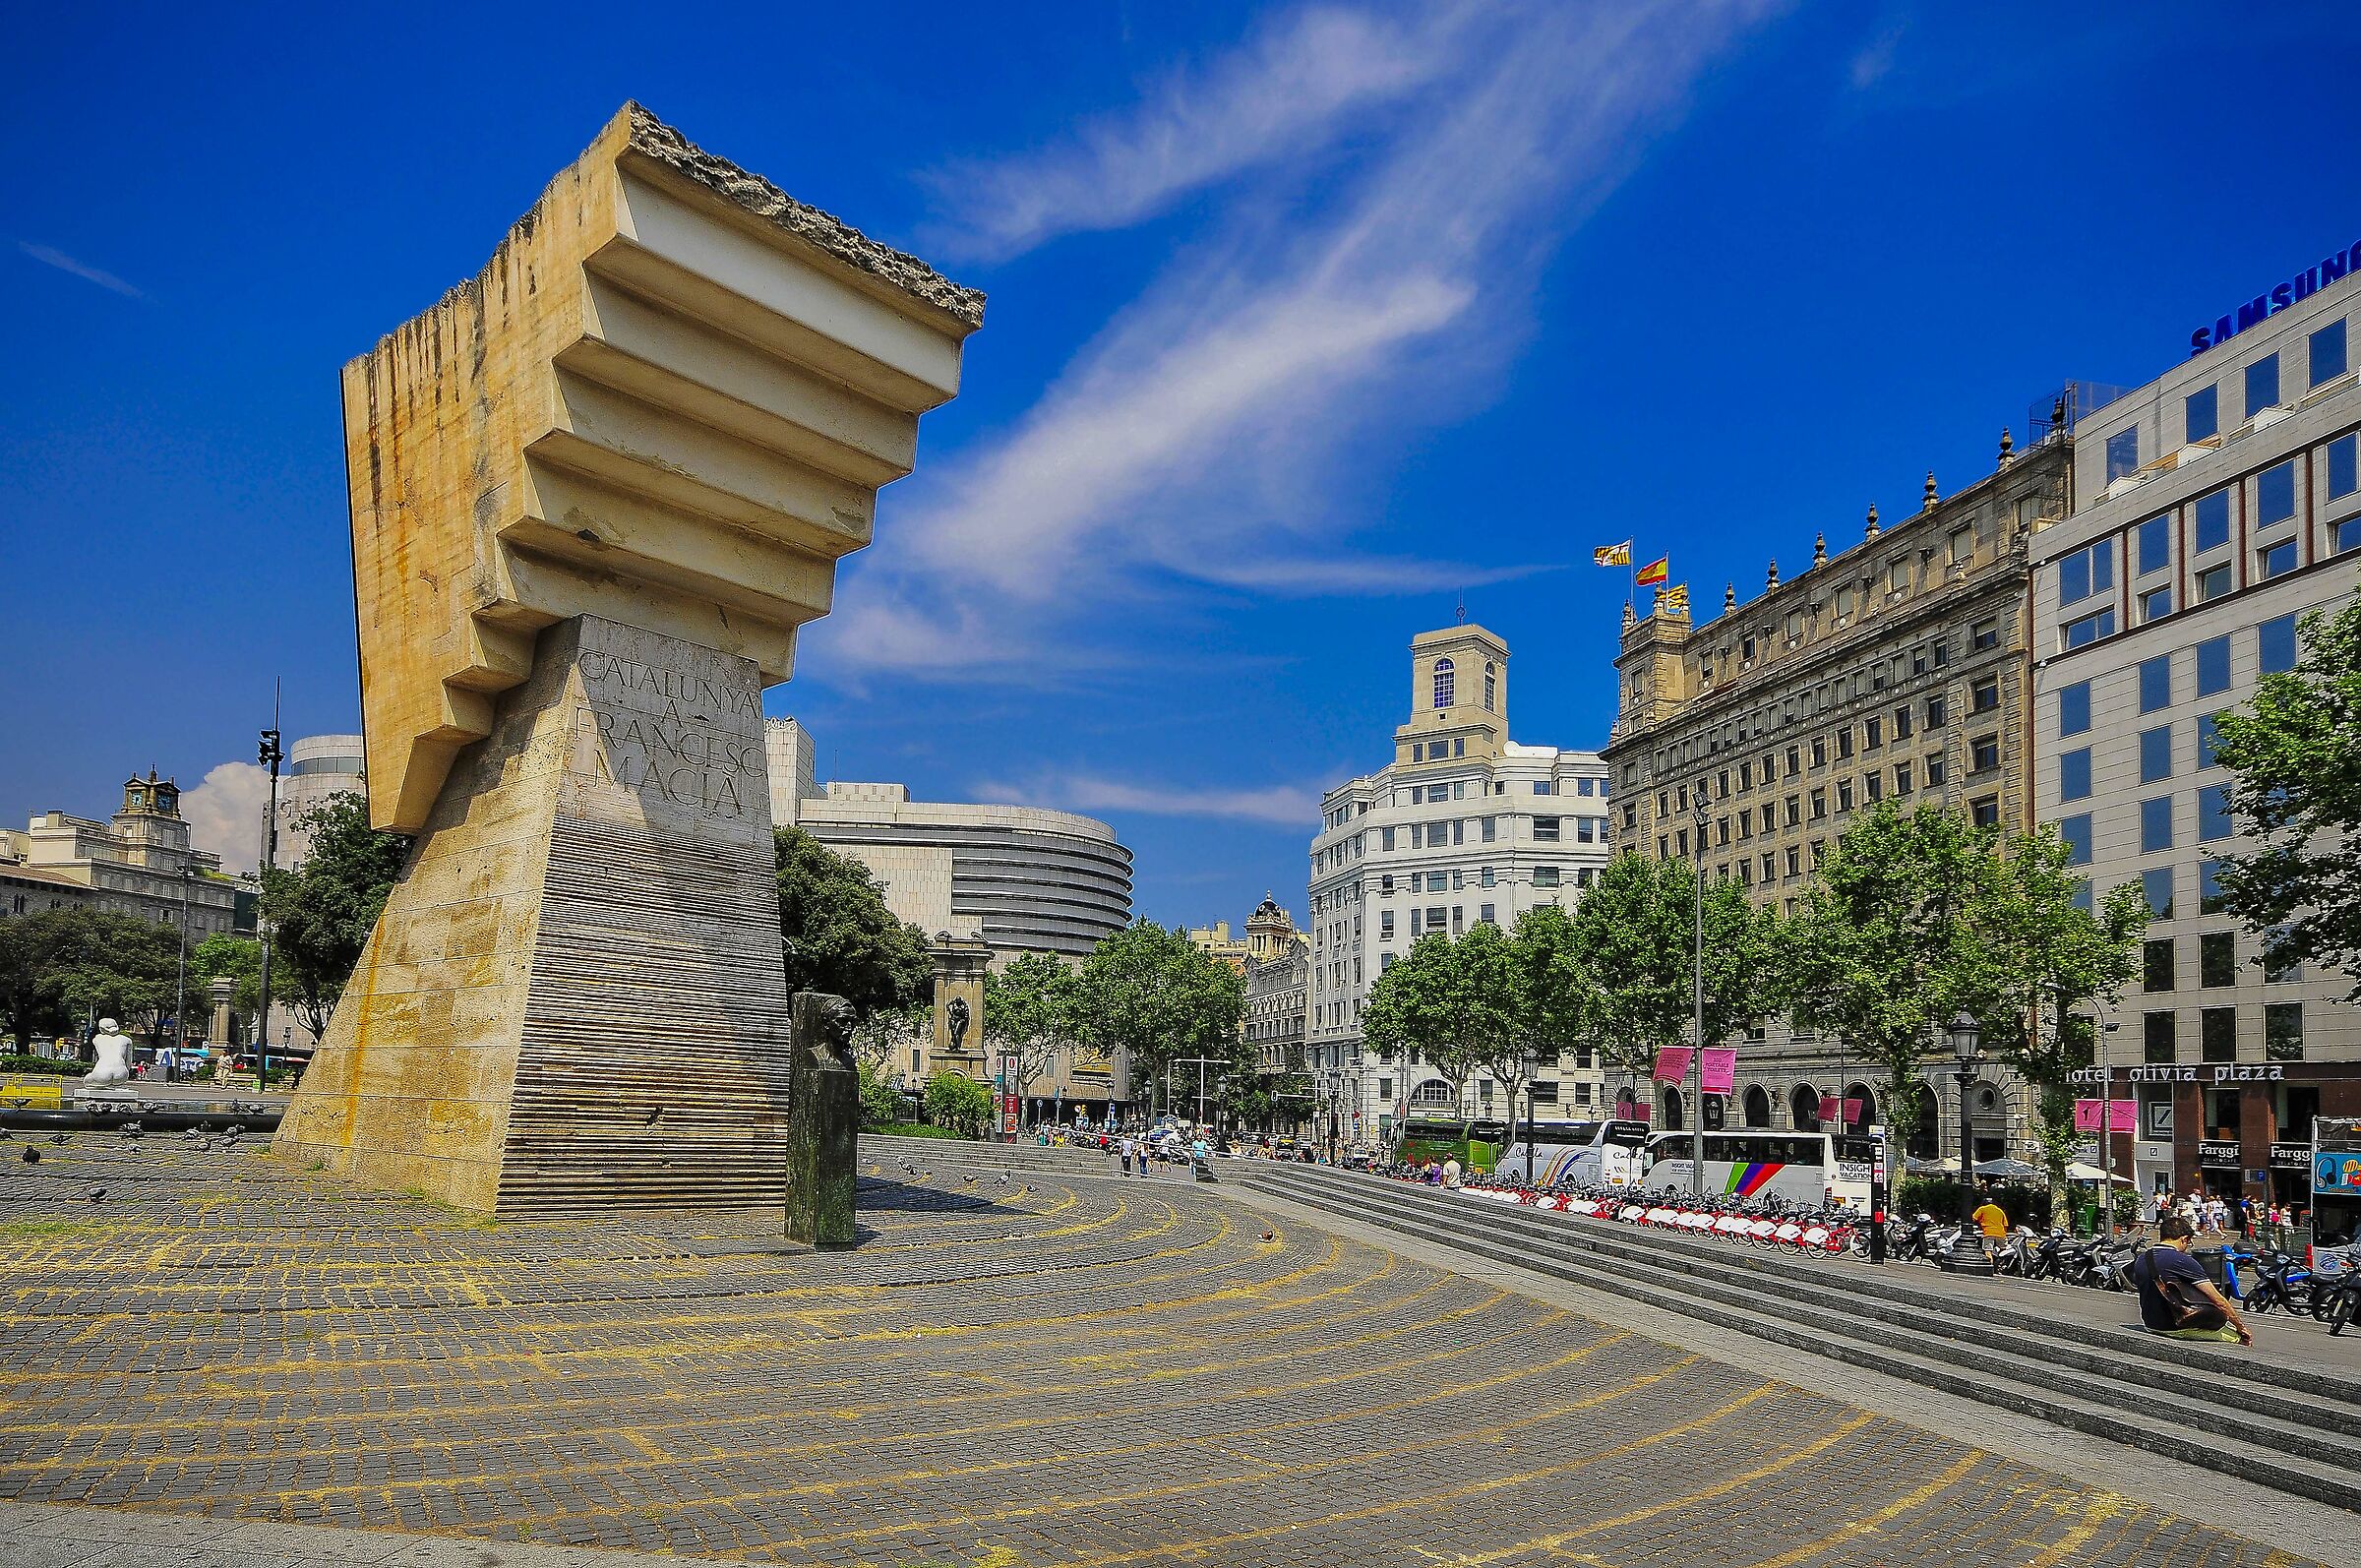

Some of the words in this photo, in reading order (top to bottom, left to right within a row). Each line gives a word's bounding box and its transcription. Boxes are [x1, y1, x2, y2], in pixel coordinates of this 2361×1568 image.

[577, 651, 759, 719] CATALUNYA
[661, 699, 683, 728] A
[575, 706, 765, 778] FRANCESC
[593, 749, 744, 816] MACIÀ
[2128, 1063, 2197, 1082] olivia
[2214, 1062, 2284, 1086] plaza
[2198, 1143, 2240, 1158] Farggi
[2270, 1145, 2312, 1162] Fargg
[1840, 1163, 1870, 1173] INSIGH
